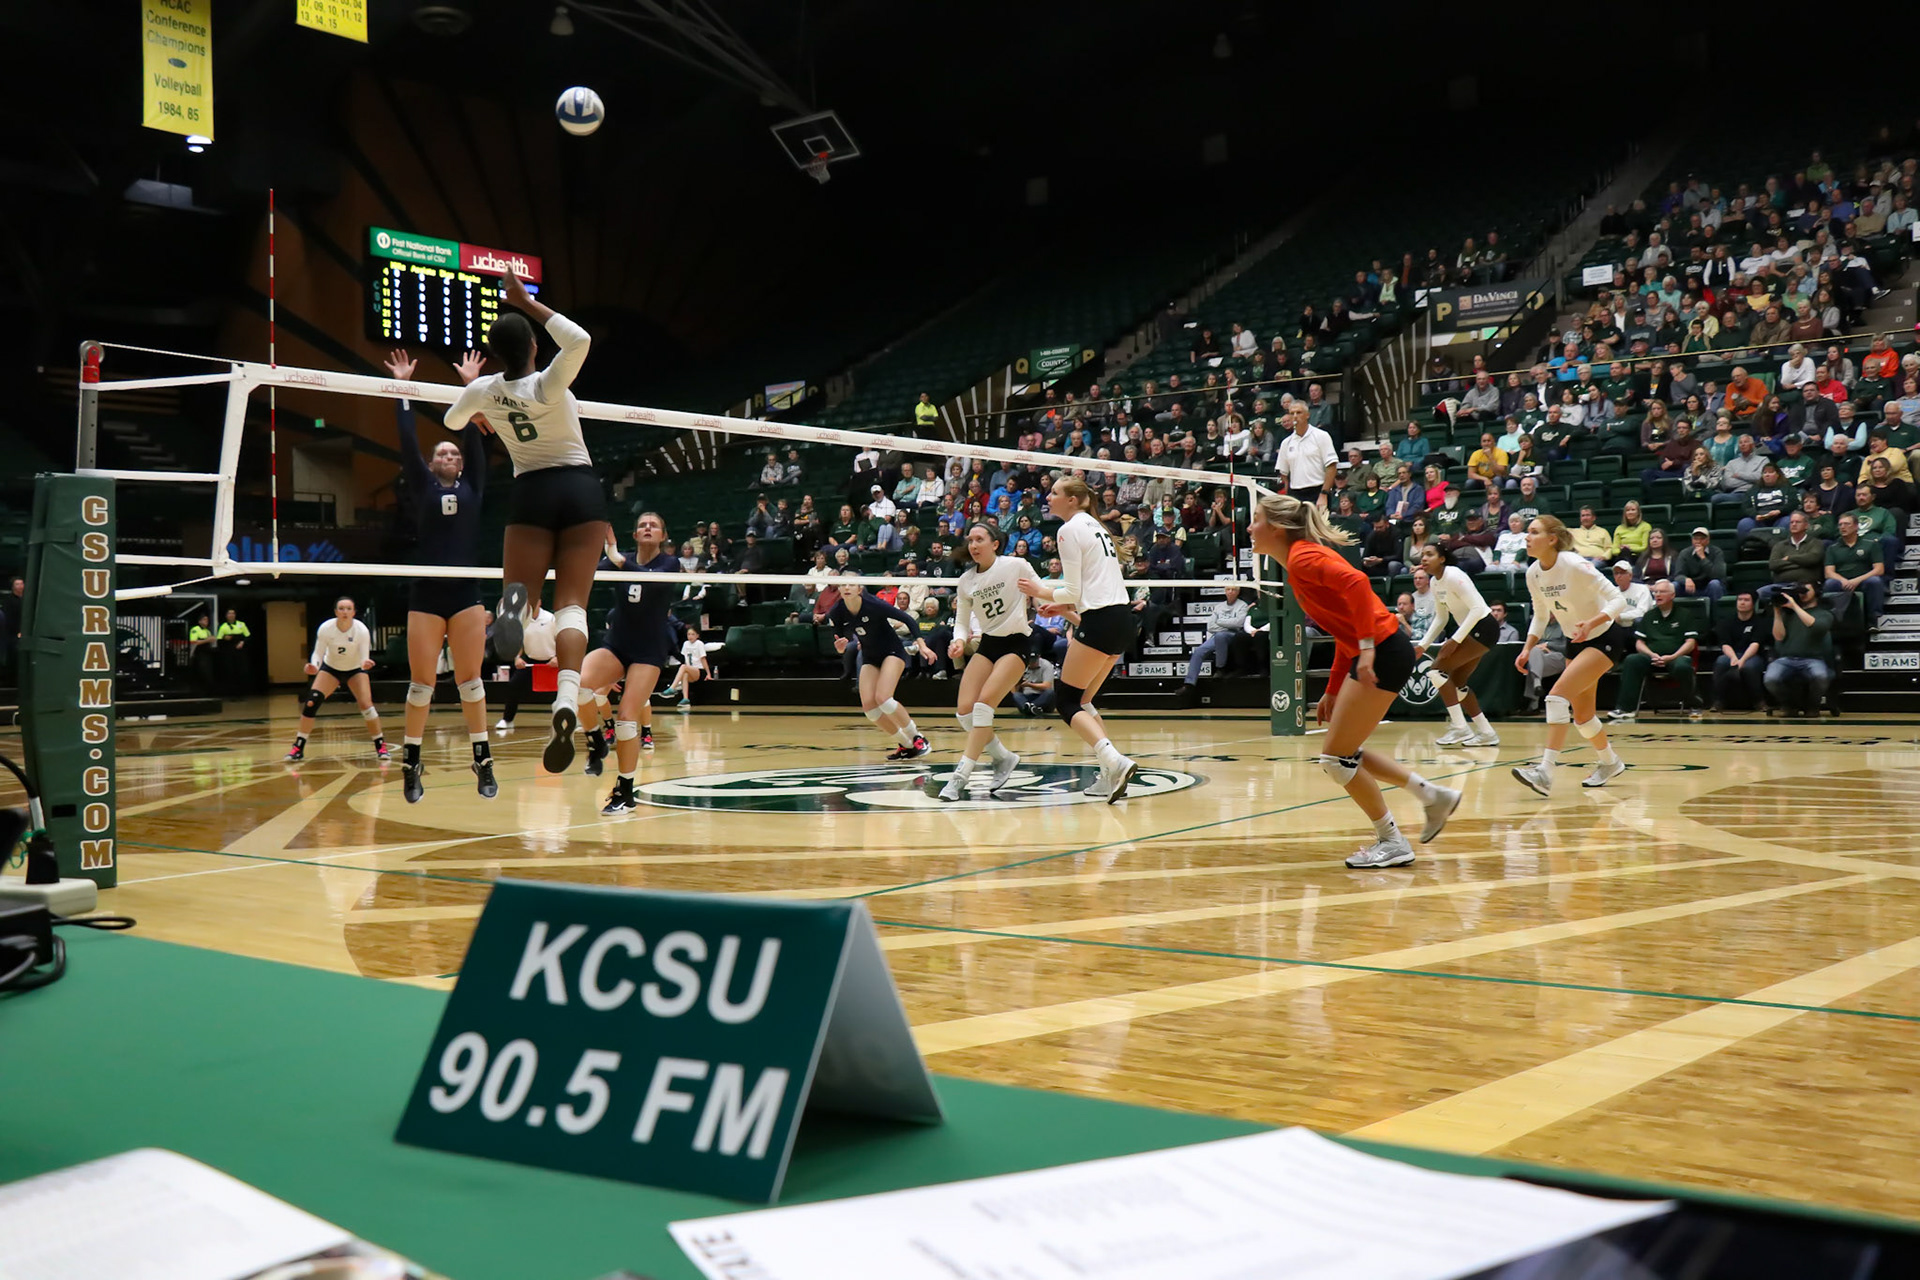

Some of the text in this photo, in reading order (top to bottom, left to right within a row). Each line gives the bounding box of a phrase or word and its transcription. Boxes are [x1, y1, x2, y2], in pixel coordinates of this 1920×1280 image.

[146, 10, 206, 37] Conference
[147, 30, 206, 56] Champions
[154, 74, 202, 96] Volleyball
[158, 101, 199, 121] 1984, 85
[392, 238, 452, 256] First National Bank
[471, 252, 530, 277] uchealth
[1437, 303, 1452, 321] P
[284, 372, 327, 386] uchealth
[381, 383, 420, 396] uchealth
[625, 410, 656, 422] uchealth
[694, 417, 722, 428] uchealth
[508, 412, 538, 442] 6
[757, 424, 784, 434] uchealth
[441, 494, 458, 515] 6
[1095, 532, 1116, 557] 13
[628, 584, 642, 603] 9
[972, 582, 1005, 597] COLORADO
[981, 590, 999, 600] STATE
[982, 598, 1005, 619] 22
[338, 647, 346, 656] 2
[1882, 658, 1918, 666] RAMS
[509, 922, 782, 1024] KCSU
[428, 1032, 789, 1160] 90.5 FM
